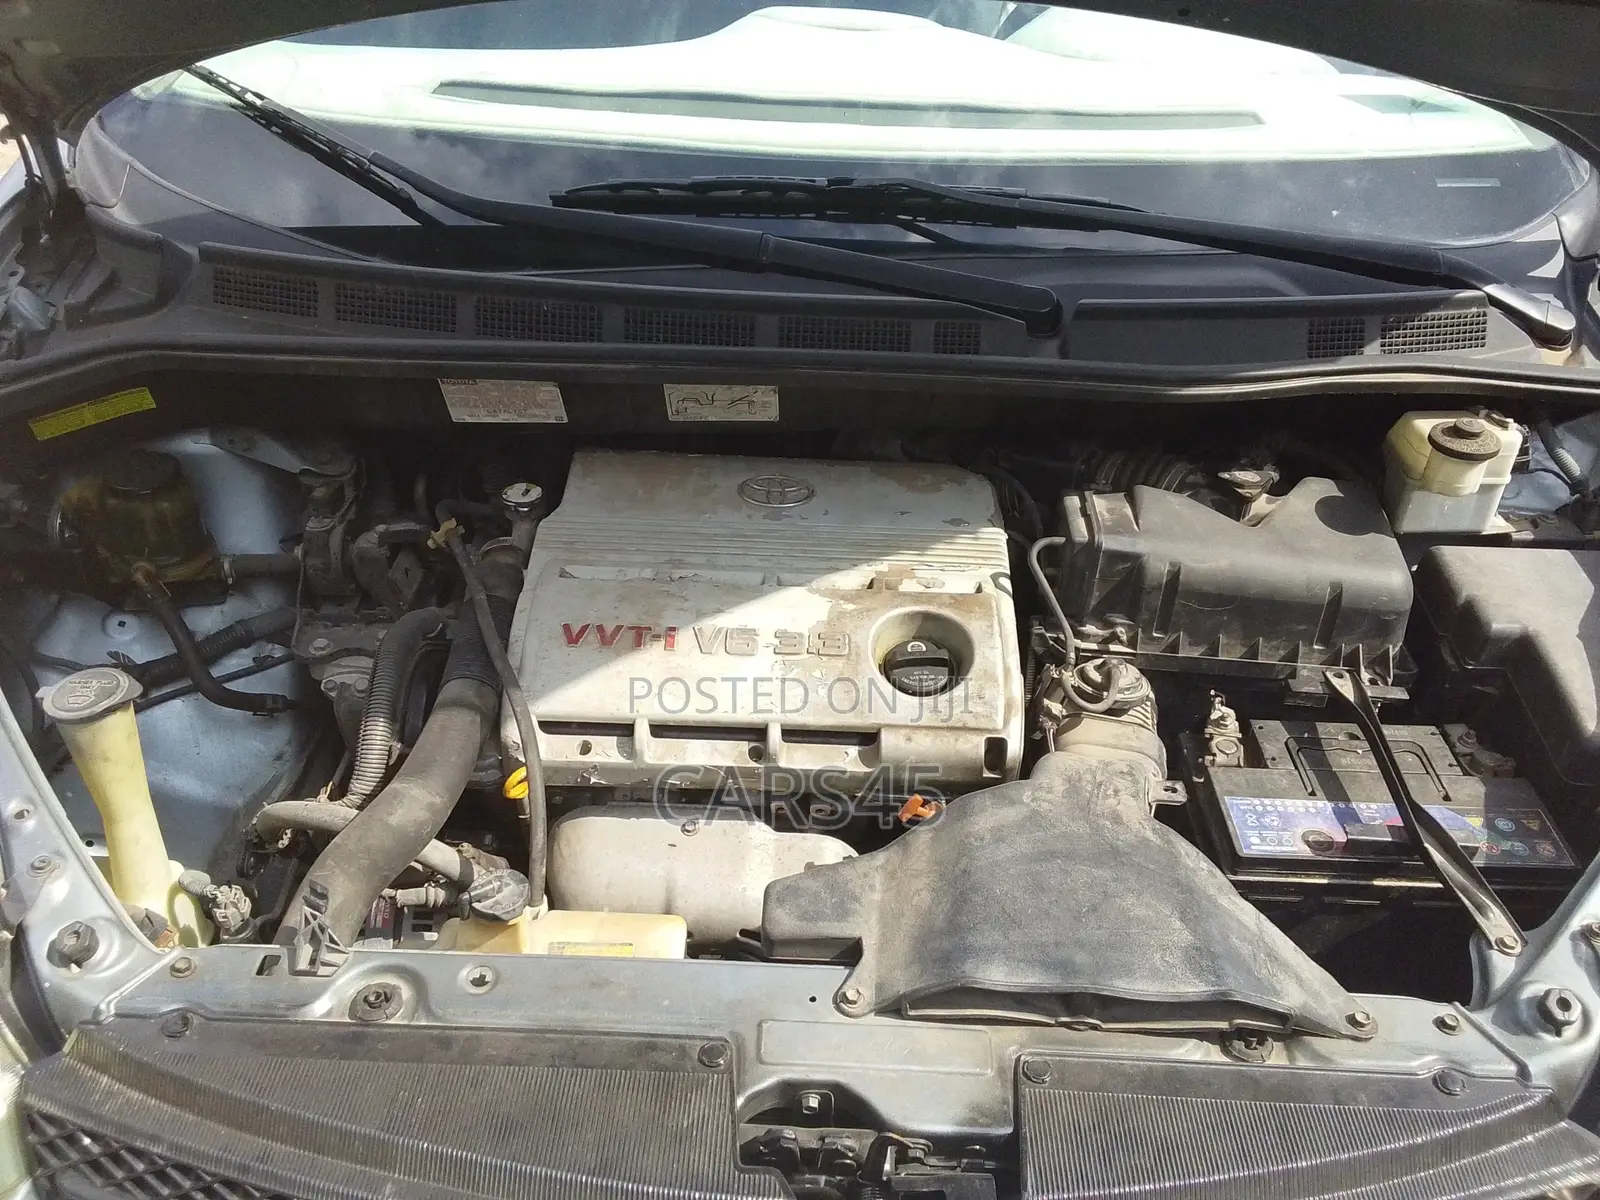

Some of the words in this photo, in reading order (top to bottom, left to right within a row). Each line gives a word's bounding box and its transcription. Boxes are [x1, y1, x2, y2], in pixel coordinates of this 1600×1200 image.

[485, 407, 529, 415] CATALYST
[692, 625, 760, 656] V6
[772, 628, 850, 656] 3.3
